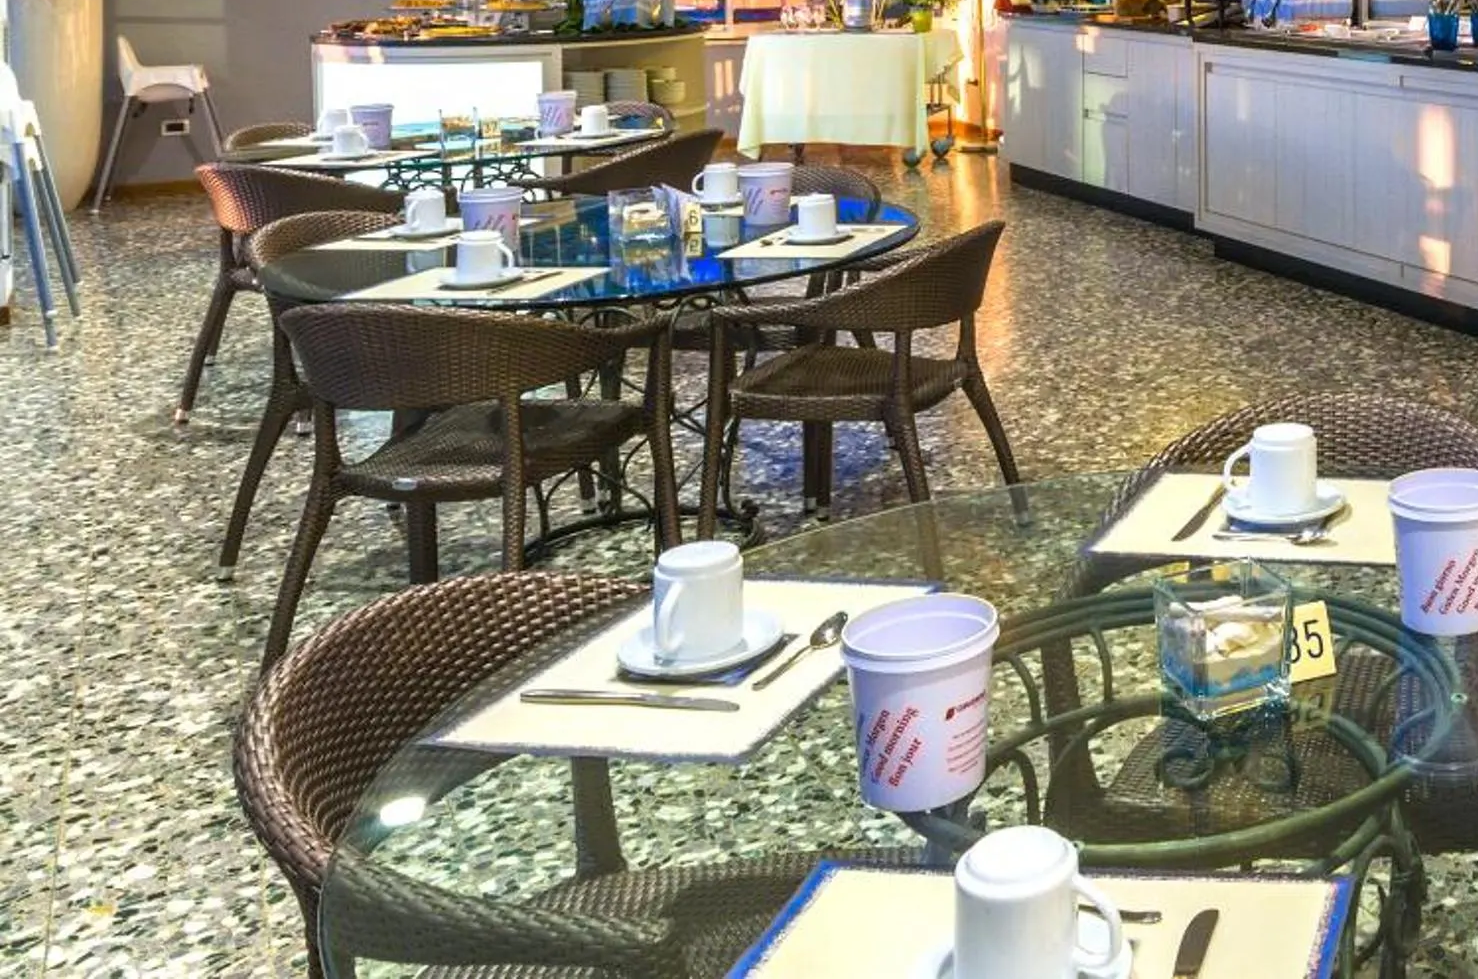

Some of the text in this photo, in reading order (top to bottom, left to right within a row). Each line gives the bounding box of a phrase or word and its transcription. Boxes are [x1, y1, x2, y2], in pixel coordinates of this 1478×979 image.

[1439, 588, 1459, 615] Guten
[1456, 586, 1475, 614] Good
[884, 707, 920, 756] morning
[888, 738, 922, 787] Bon jour
